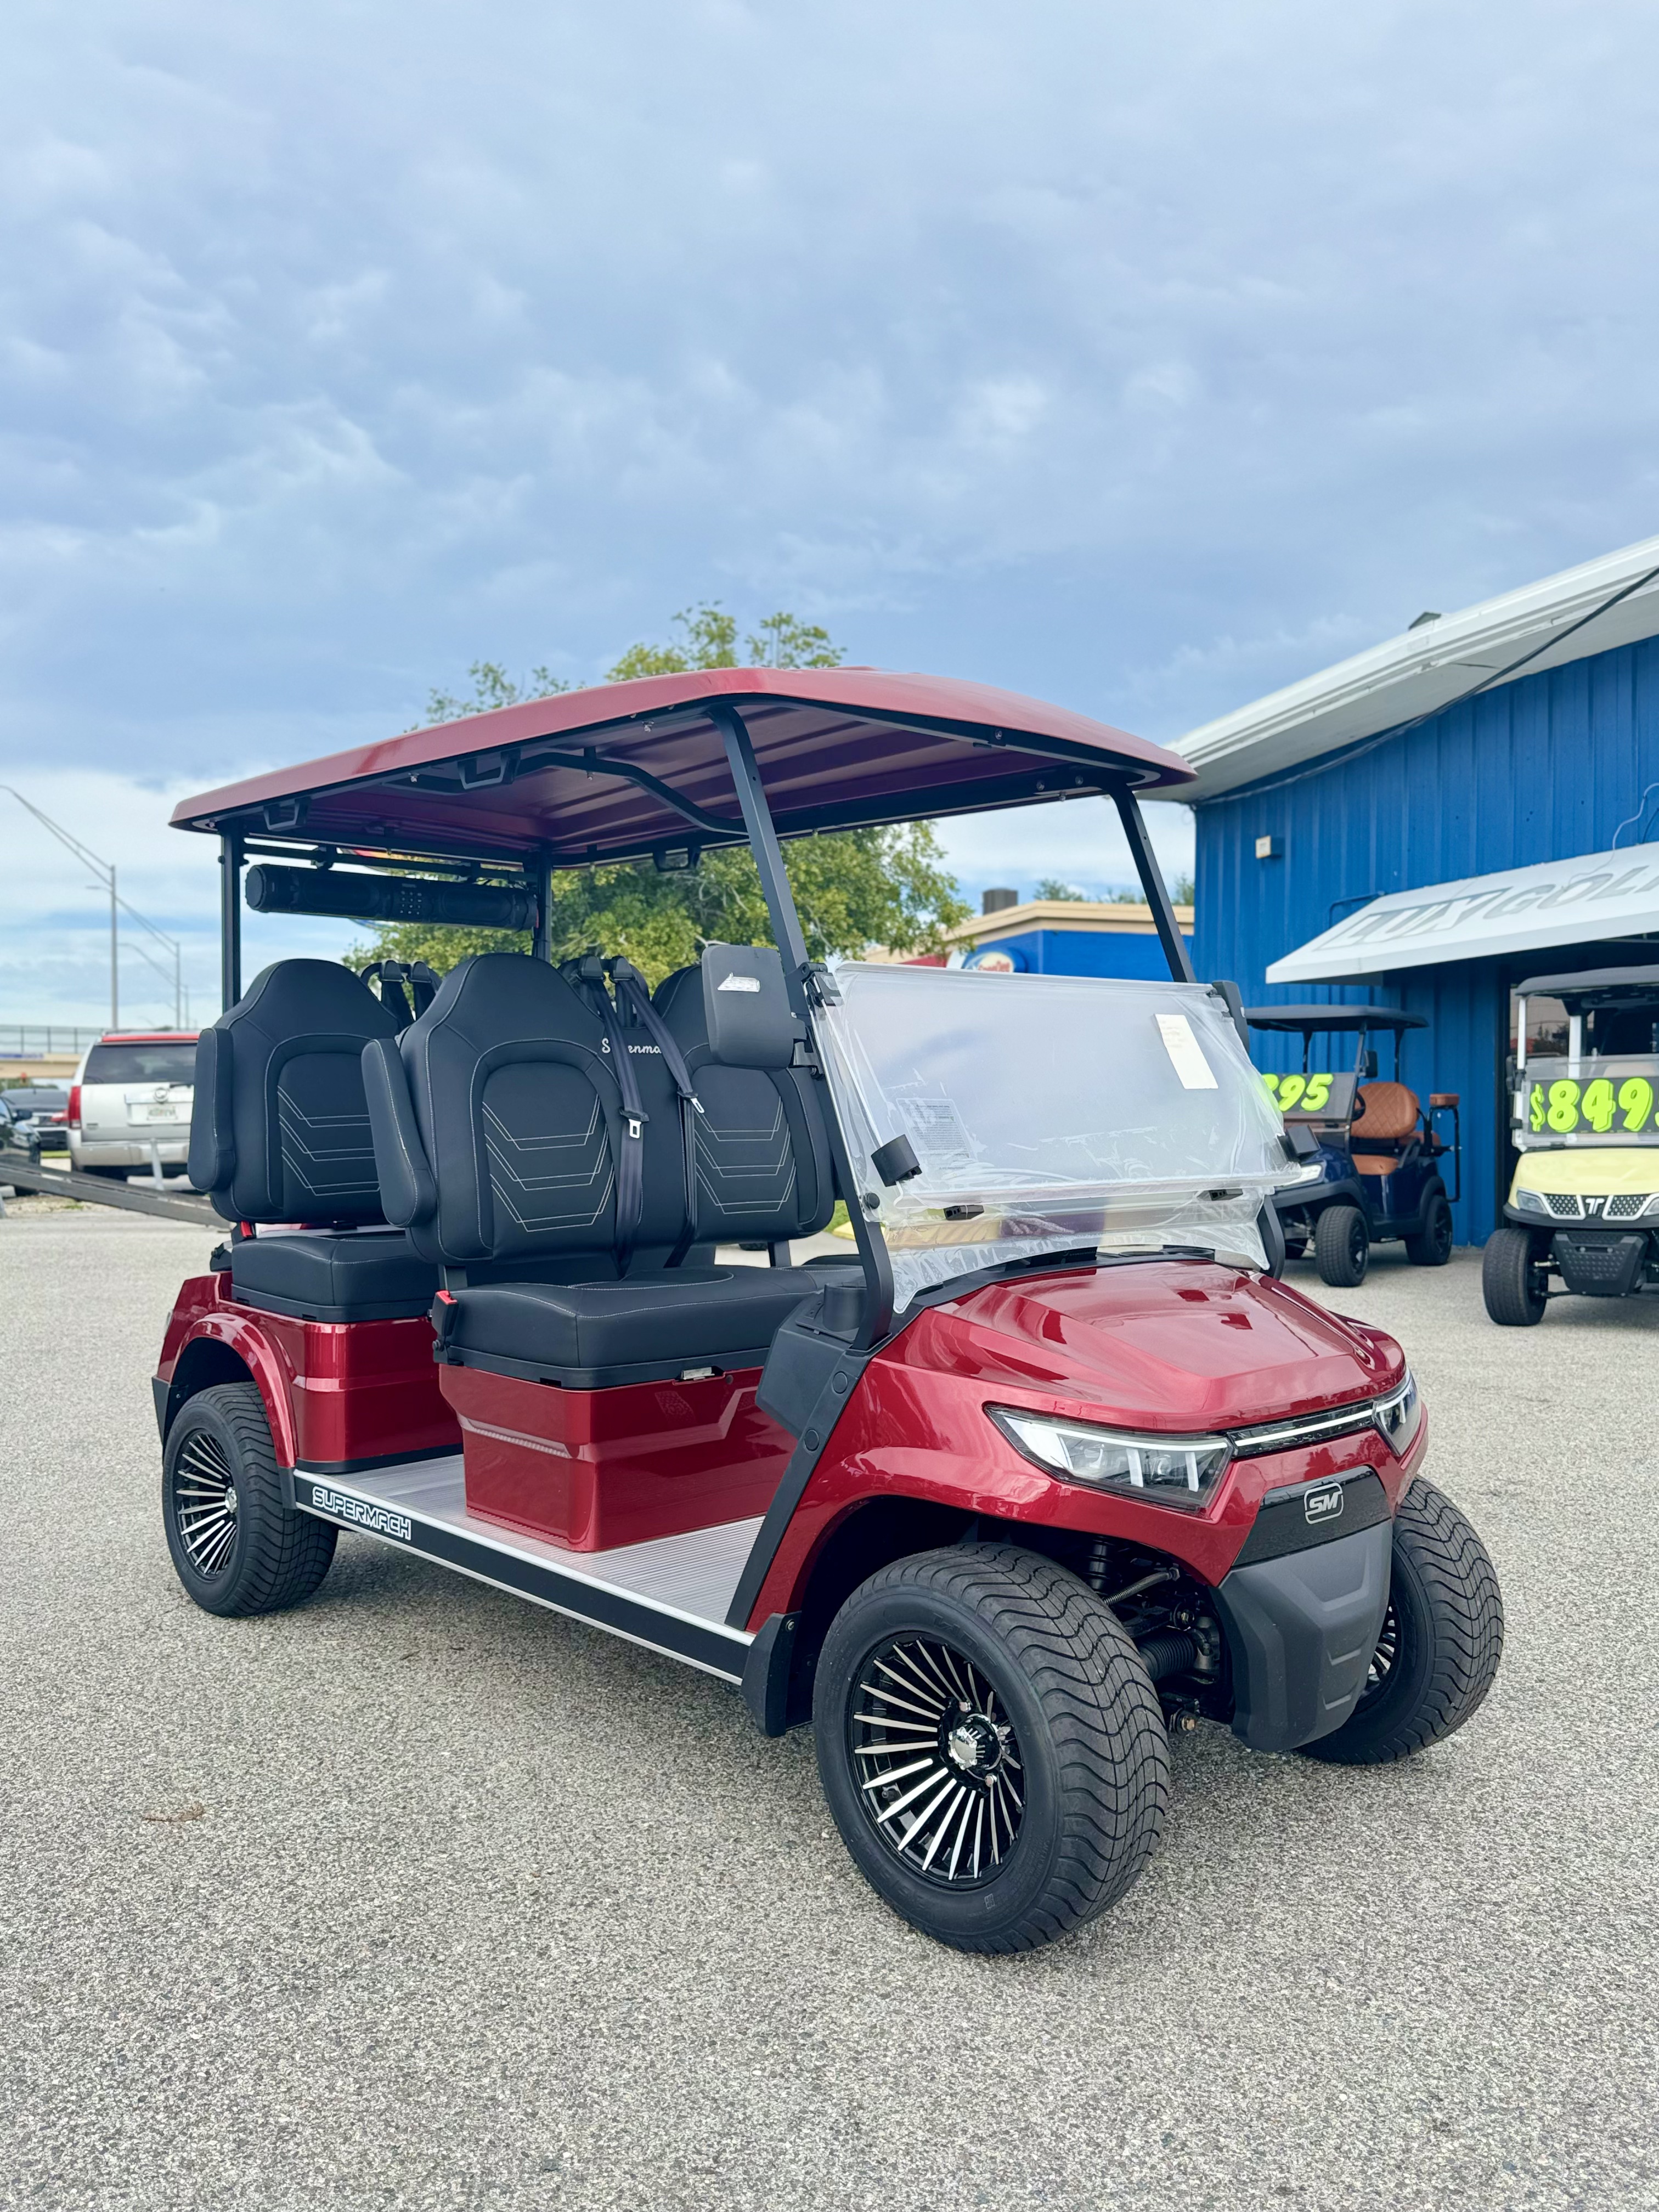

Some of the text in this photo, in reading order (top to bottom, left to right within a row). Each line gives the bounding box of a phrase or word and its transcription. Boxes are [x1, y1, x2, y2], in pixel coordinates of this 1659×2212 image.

[1530, 1077, 1659, 1133] $849
[312, 1486, 411, 1541] SUPERMACH
[1306, 1492, 1340, 1515] SM
